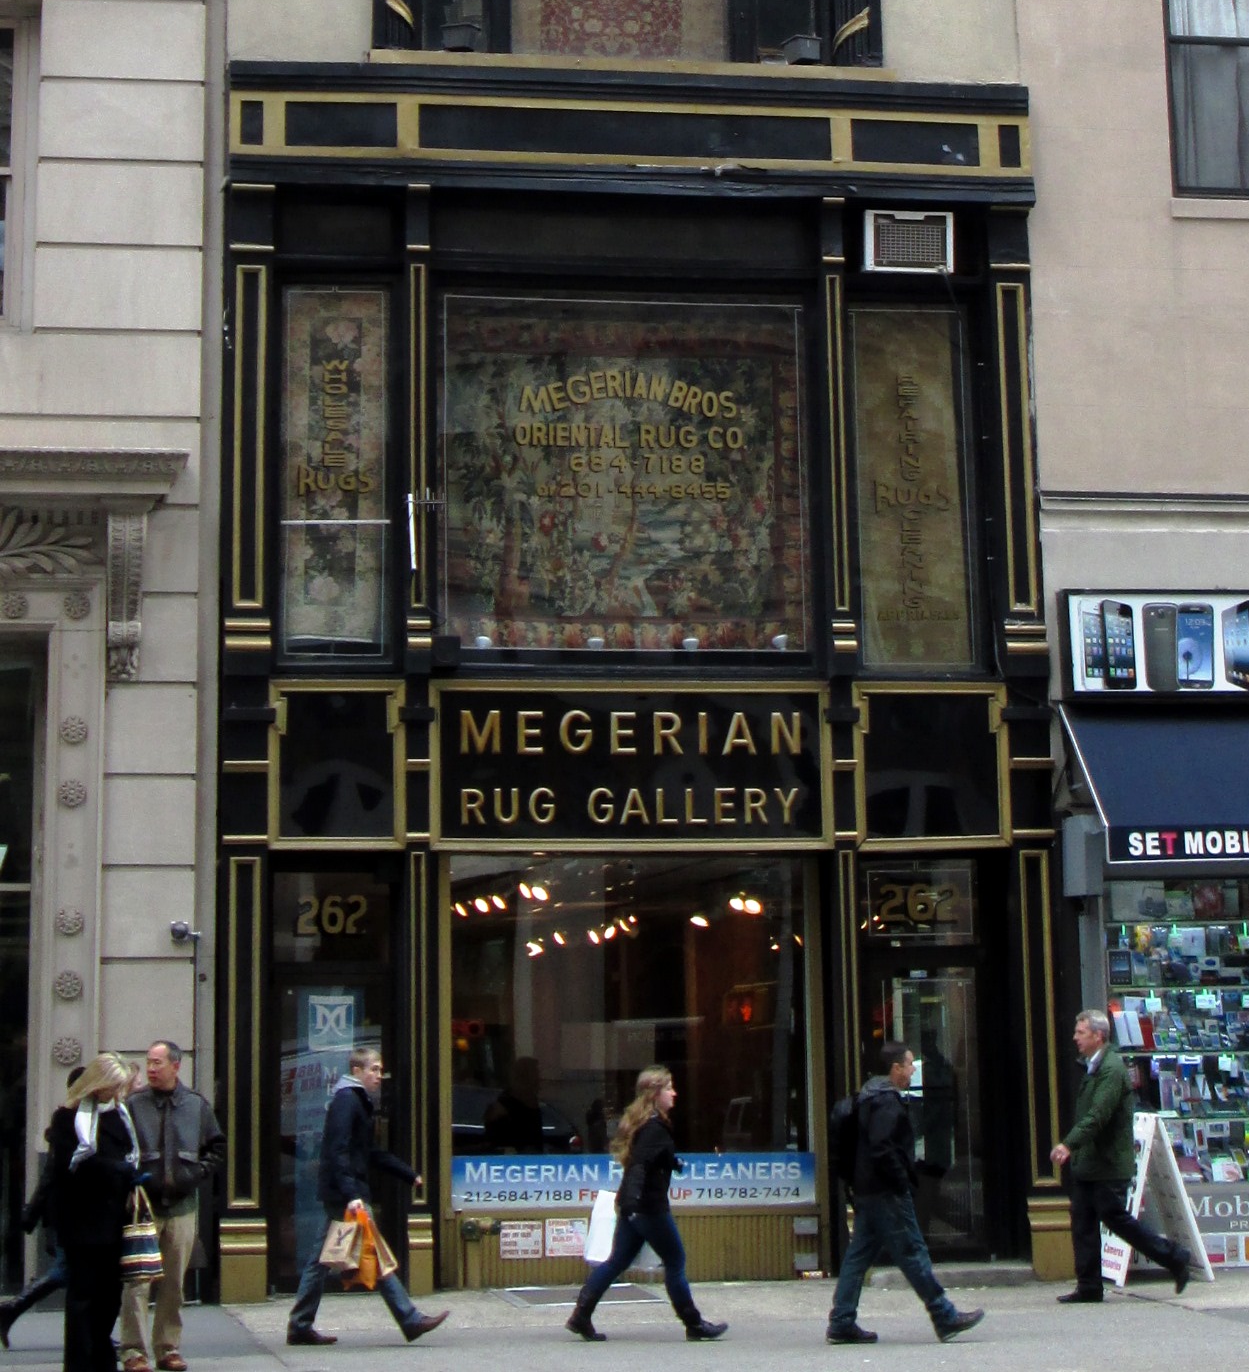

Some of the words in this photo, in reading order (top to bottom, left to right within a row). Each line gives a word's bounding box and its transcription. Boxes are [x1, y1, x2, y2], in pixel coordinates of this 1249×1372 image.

[519, 370, 666, 414] MEGERIAN
[321, 359, 349, 468] WHOLESALE
[514, 423, 630, 448] ORIENTAL
[640, 425, 698, 448] RUG
[569, 453, 706, 474] 684-7188
[297, 465, 374, 496] RUGS
[874, 480, 950, 512] RUGS
[459, 709, 802, 755] MEGERIAN
[460, 787, 556, 825] RUG
[587, 787, 799, 825] GALLERY
[1128, 831, 1177, 856] SET
[296, 893, 368, 935] 262
[880, 882, 960, 923] 262
[465, 1161, 599, 1183] MEGERIAN
[463, 1190, 573, 1203] 212-684-7188
[696, 1187, 800, 1199] 718-782-7474
